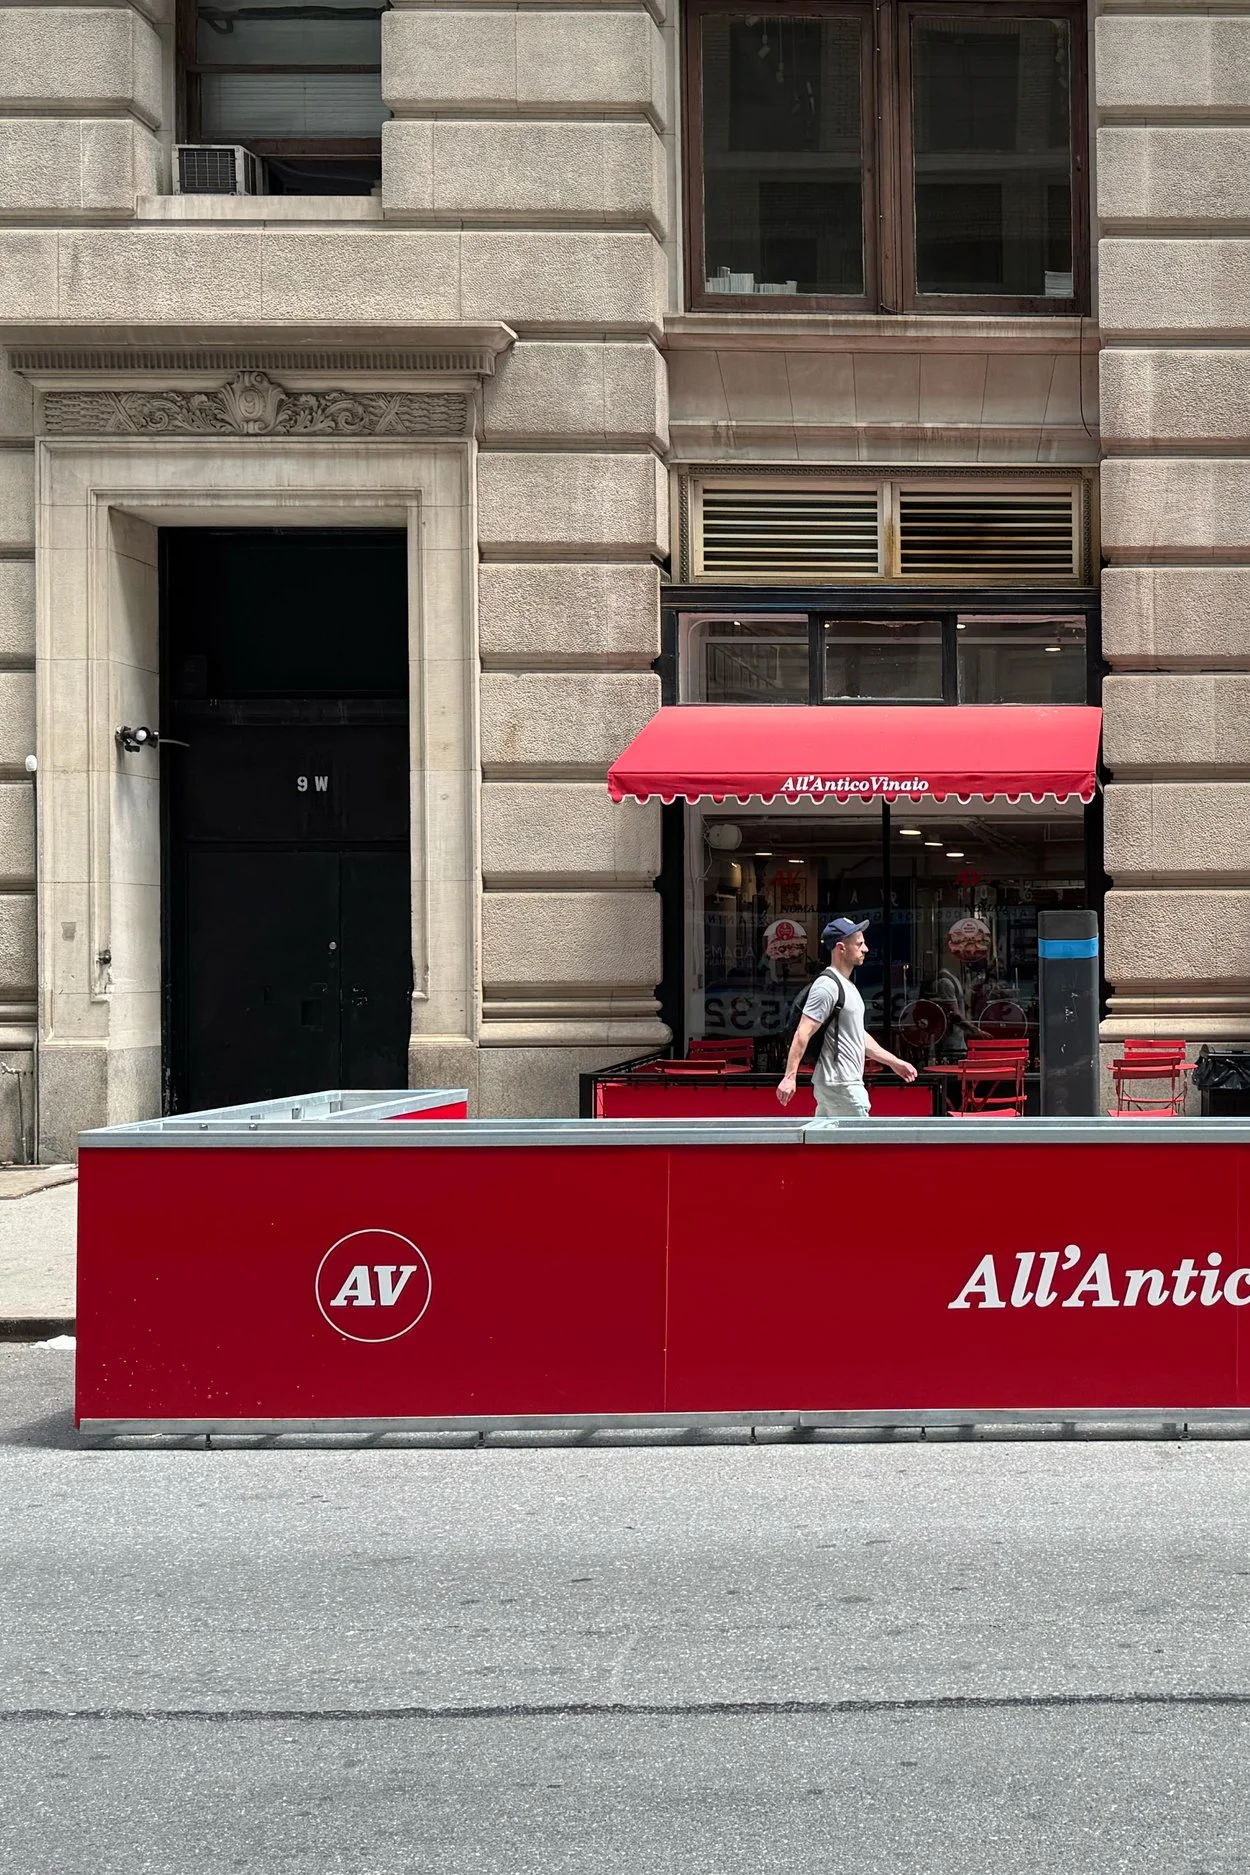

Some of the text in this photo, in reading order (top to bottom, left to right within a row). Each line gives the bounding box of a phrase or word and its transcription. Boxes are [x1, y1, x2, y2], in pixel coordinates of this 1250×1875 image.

[297, 776, 328, 792] 9 W
[330, 1265, 417, 1306] AV
